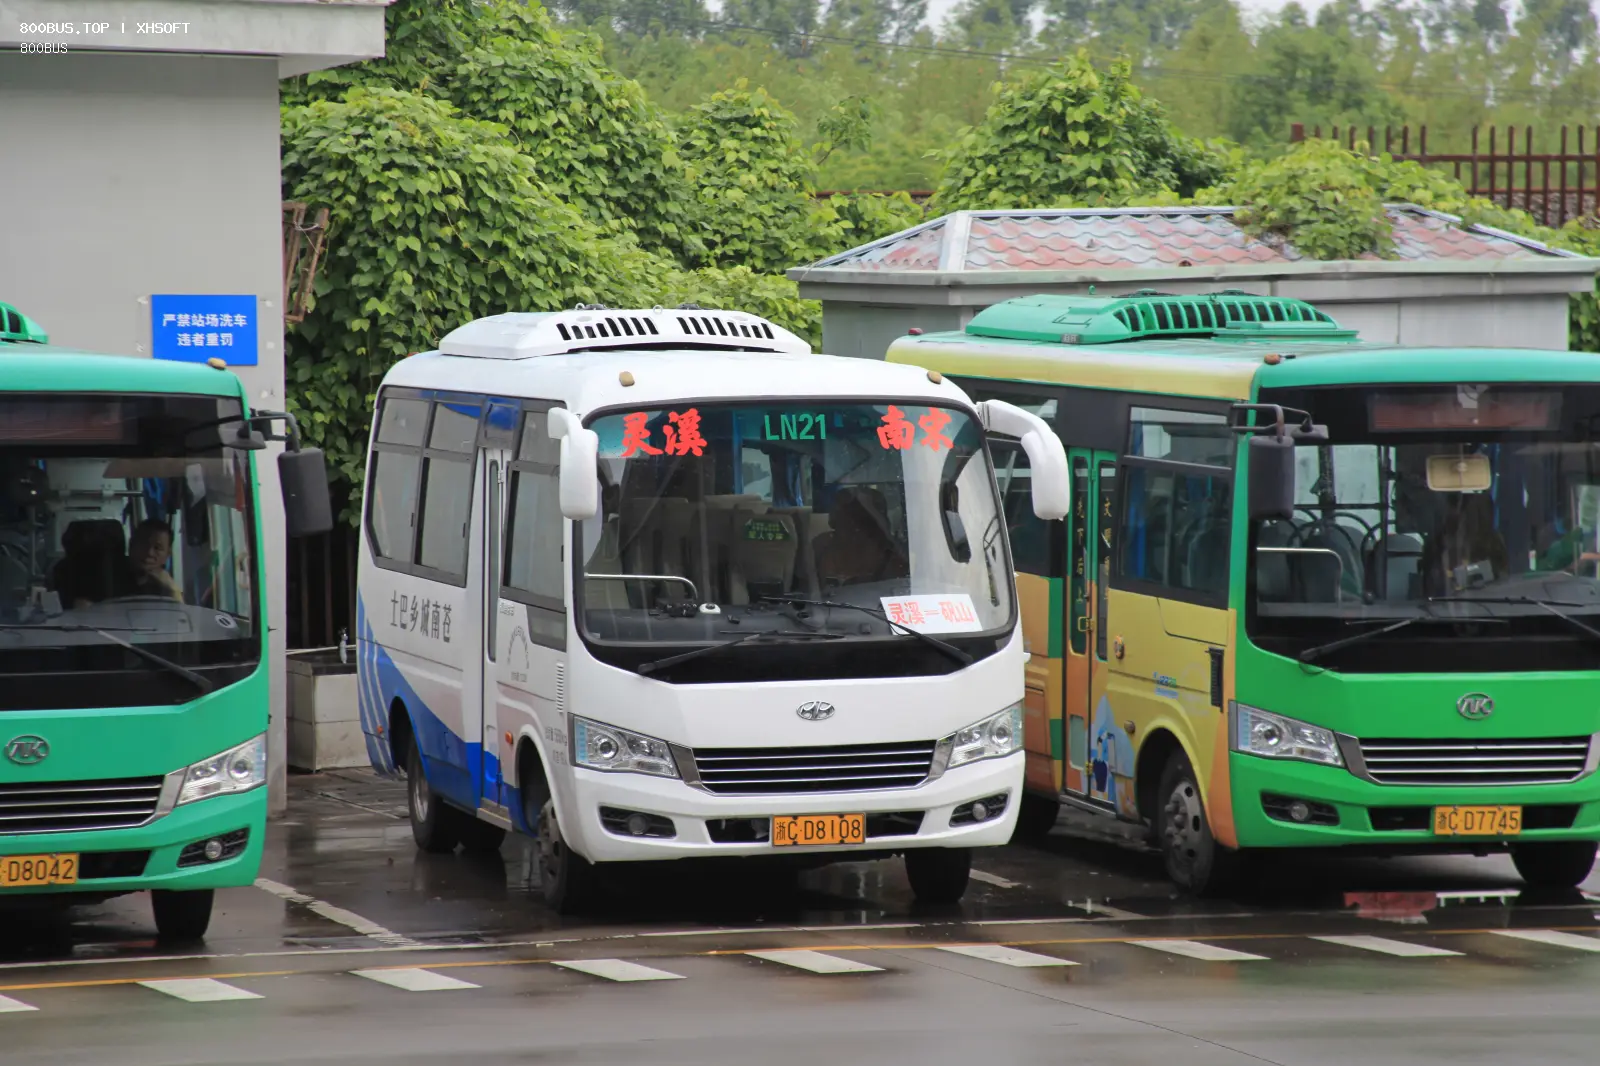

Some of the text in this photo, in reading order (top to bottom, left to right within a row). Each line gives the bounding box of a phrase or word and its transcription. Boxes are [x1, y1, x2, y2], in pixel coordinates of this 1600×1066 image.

[162, 313, 248, 327] 严禁站场洗车
[177, 332, 233, 347] 违者重罚
[620, 405, 954, 457] 灵溪 LN21 南宋
